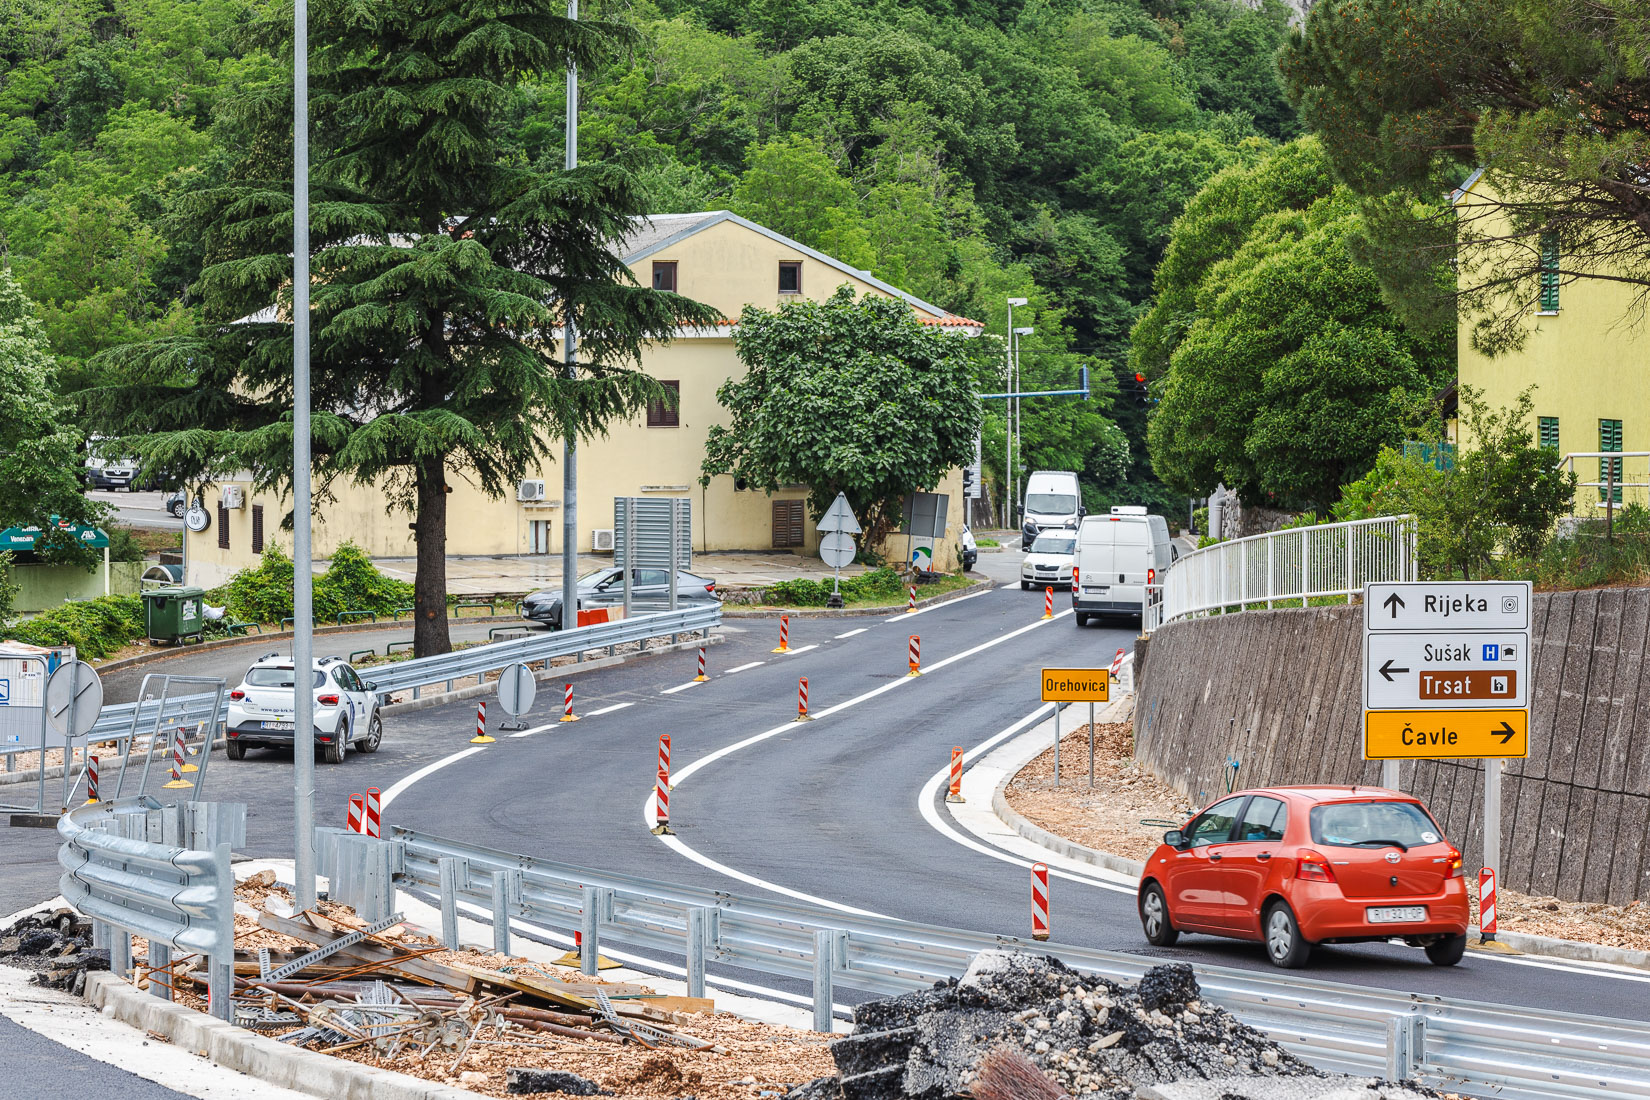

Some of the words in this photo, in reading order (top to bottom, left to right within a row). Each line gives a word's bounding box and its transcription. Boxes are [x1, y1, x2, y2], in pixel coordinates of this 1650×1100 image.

[1424, 594, 1488, 617] Rijeka
[1424, 644, 1471, 661] Sušak
[1046, 678, 1105, 691] Orehovica
[1423, 675, 1472, 694] Trsat
[1402, 722, 1458, 745] Čavle
